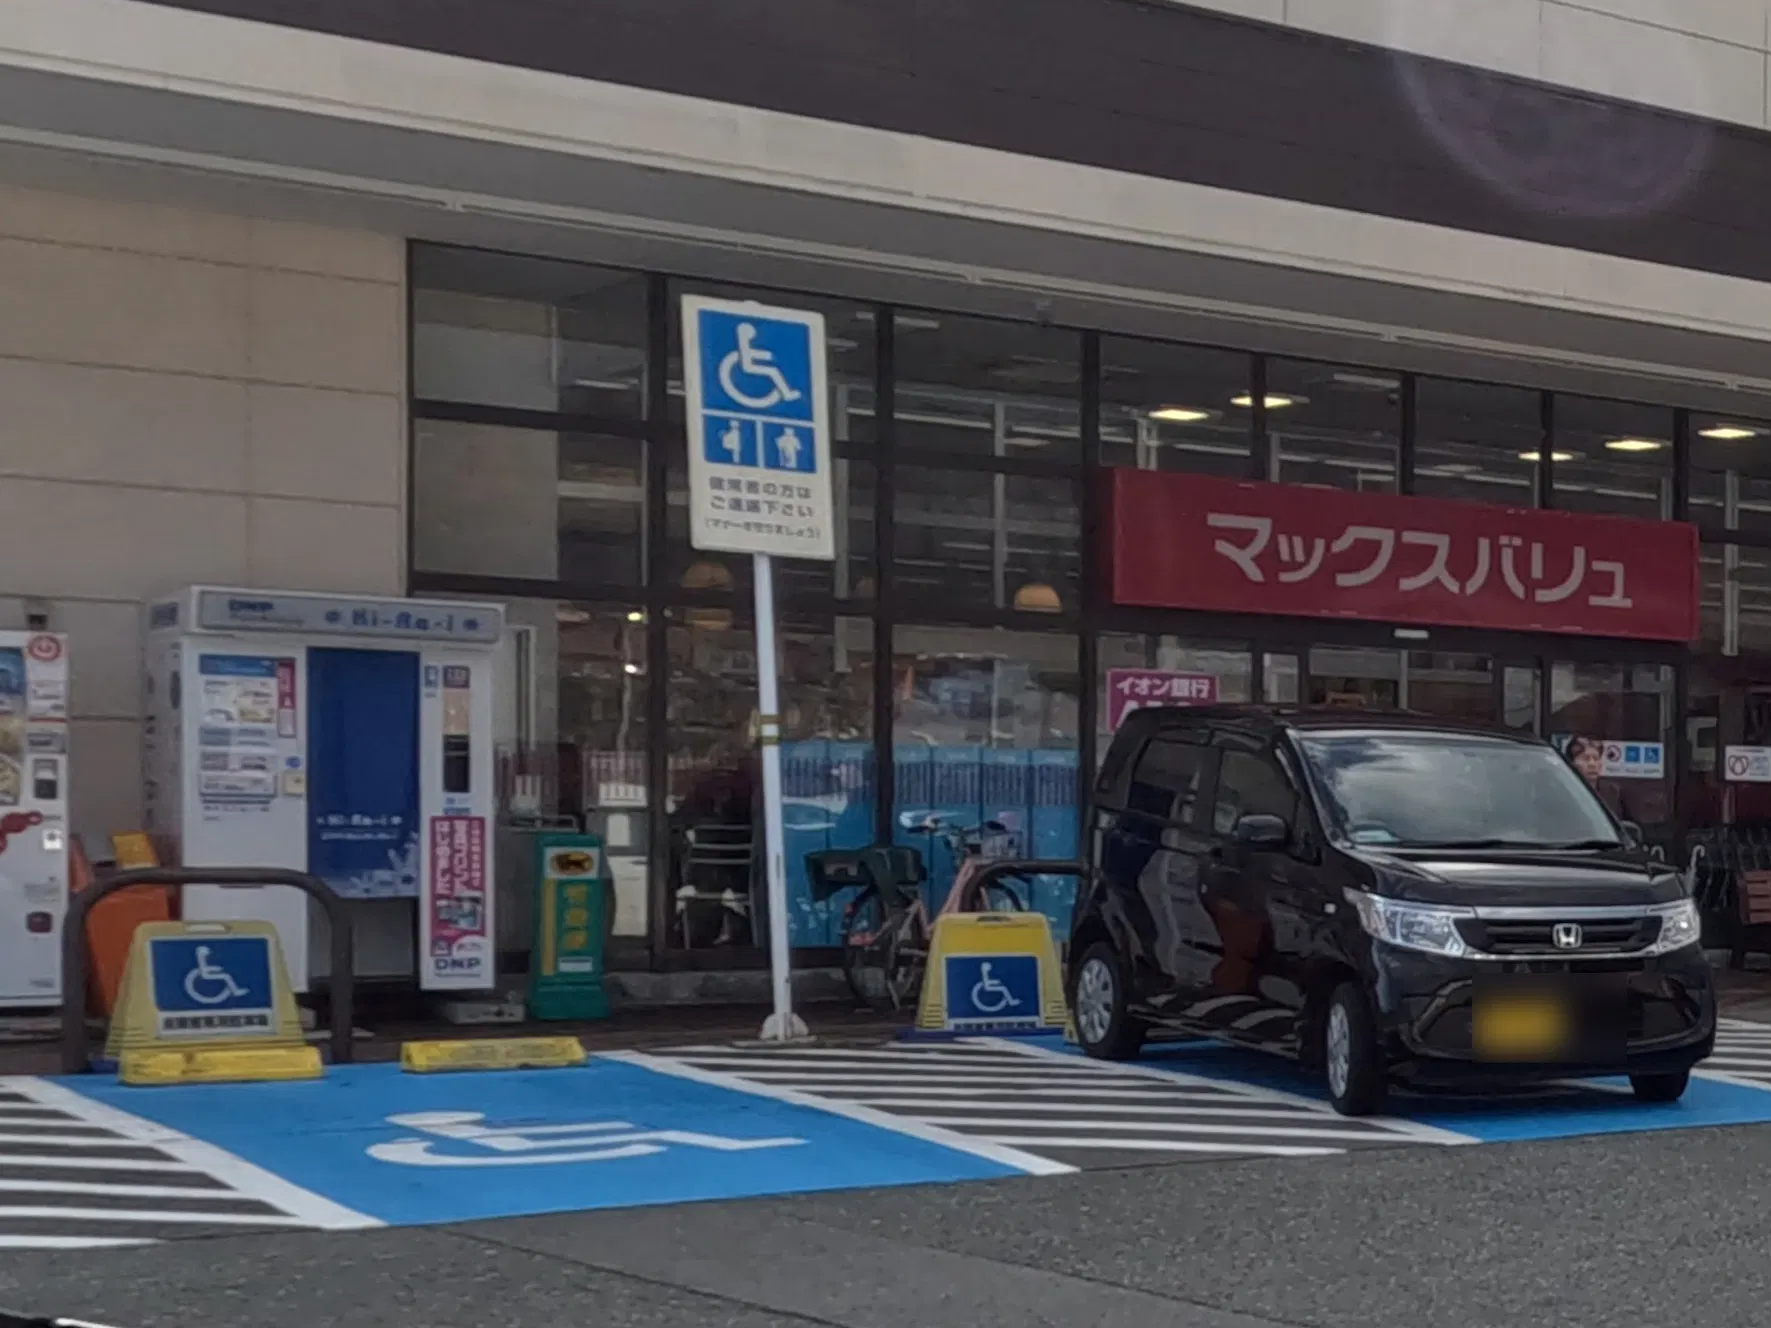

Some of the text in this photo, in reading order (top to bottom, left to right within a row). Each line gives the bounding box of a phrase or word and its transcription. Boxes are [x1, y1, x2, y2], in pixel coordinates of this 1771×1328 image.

[1207, 513, 1633, 608] マックスバリュ
[1116, 676, 1211, 699] イオン銀行
